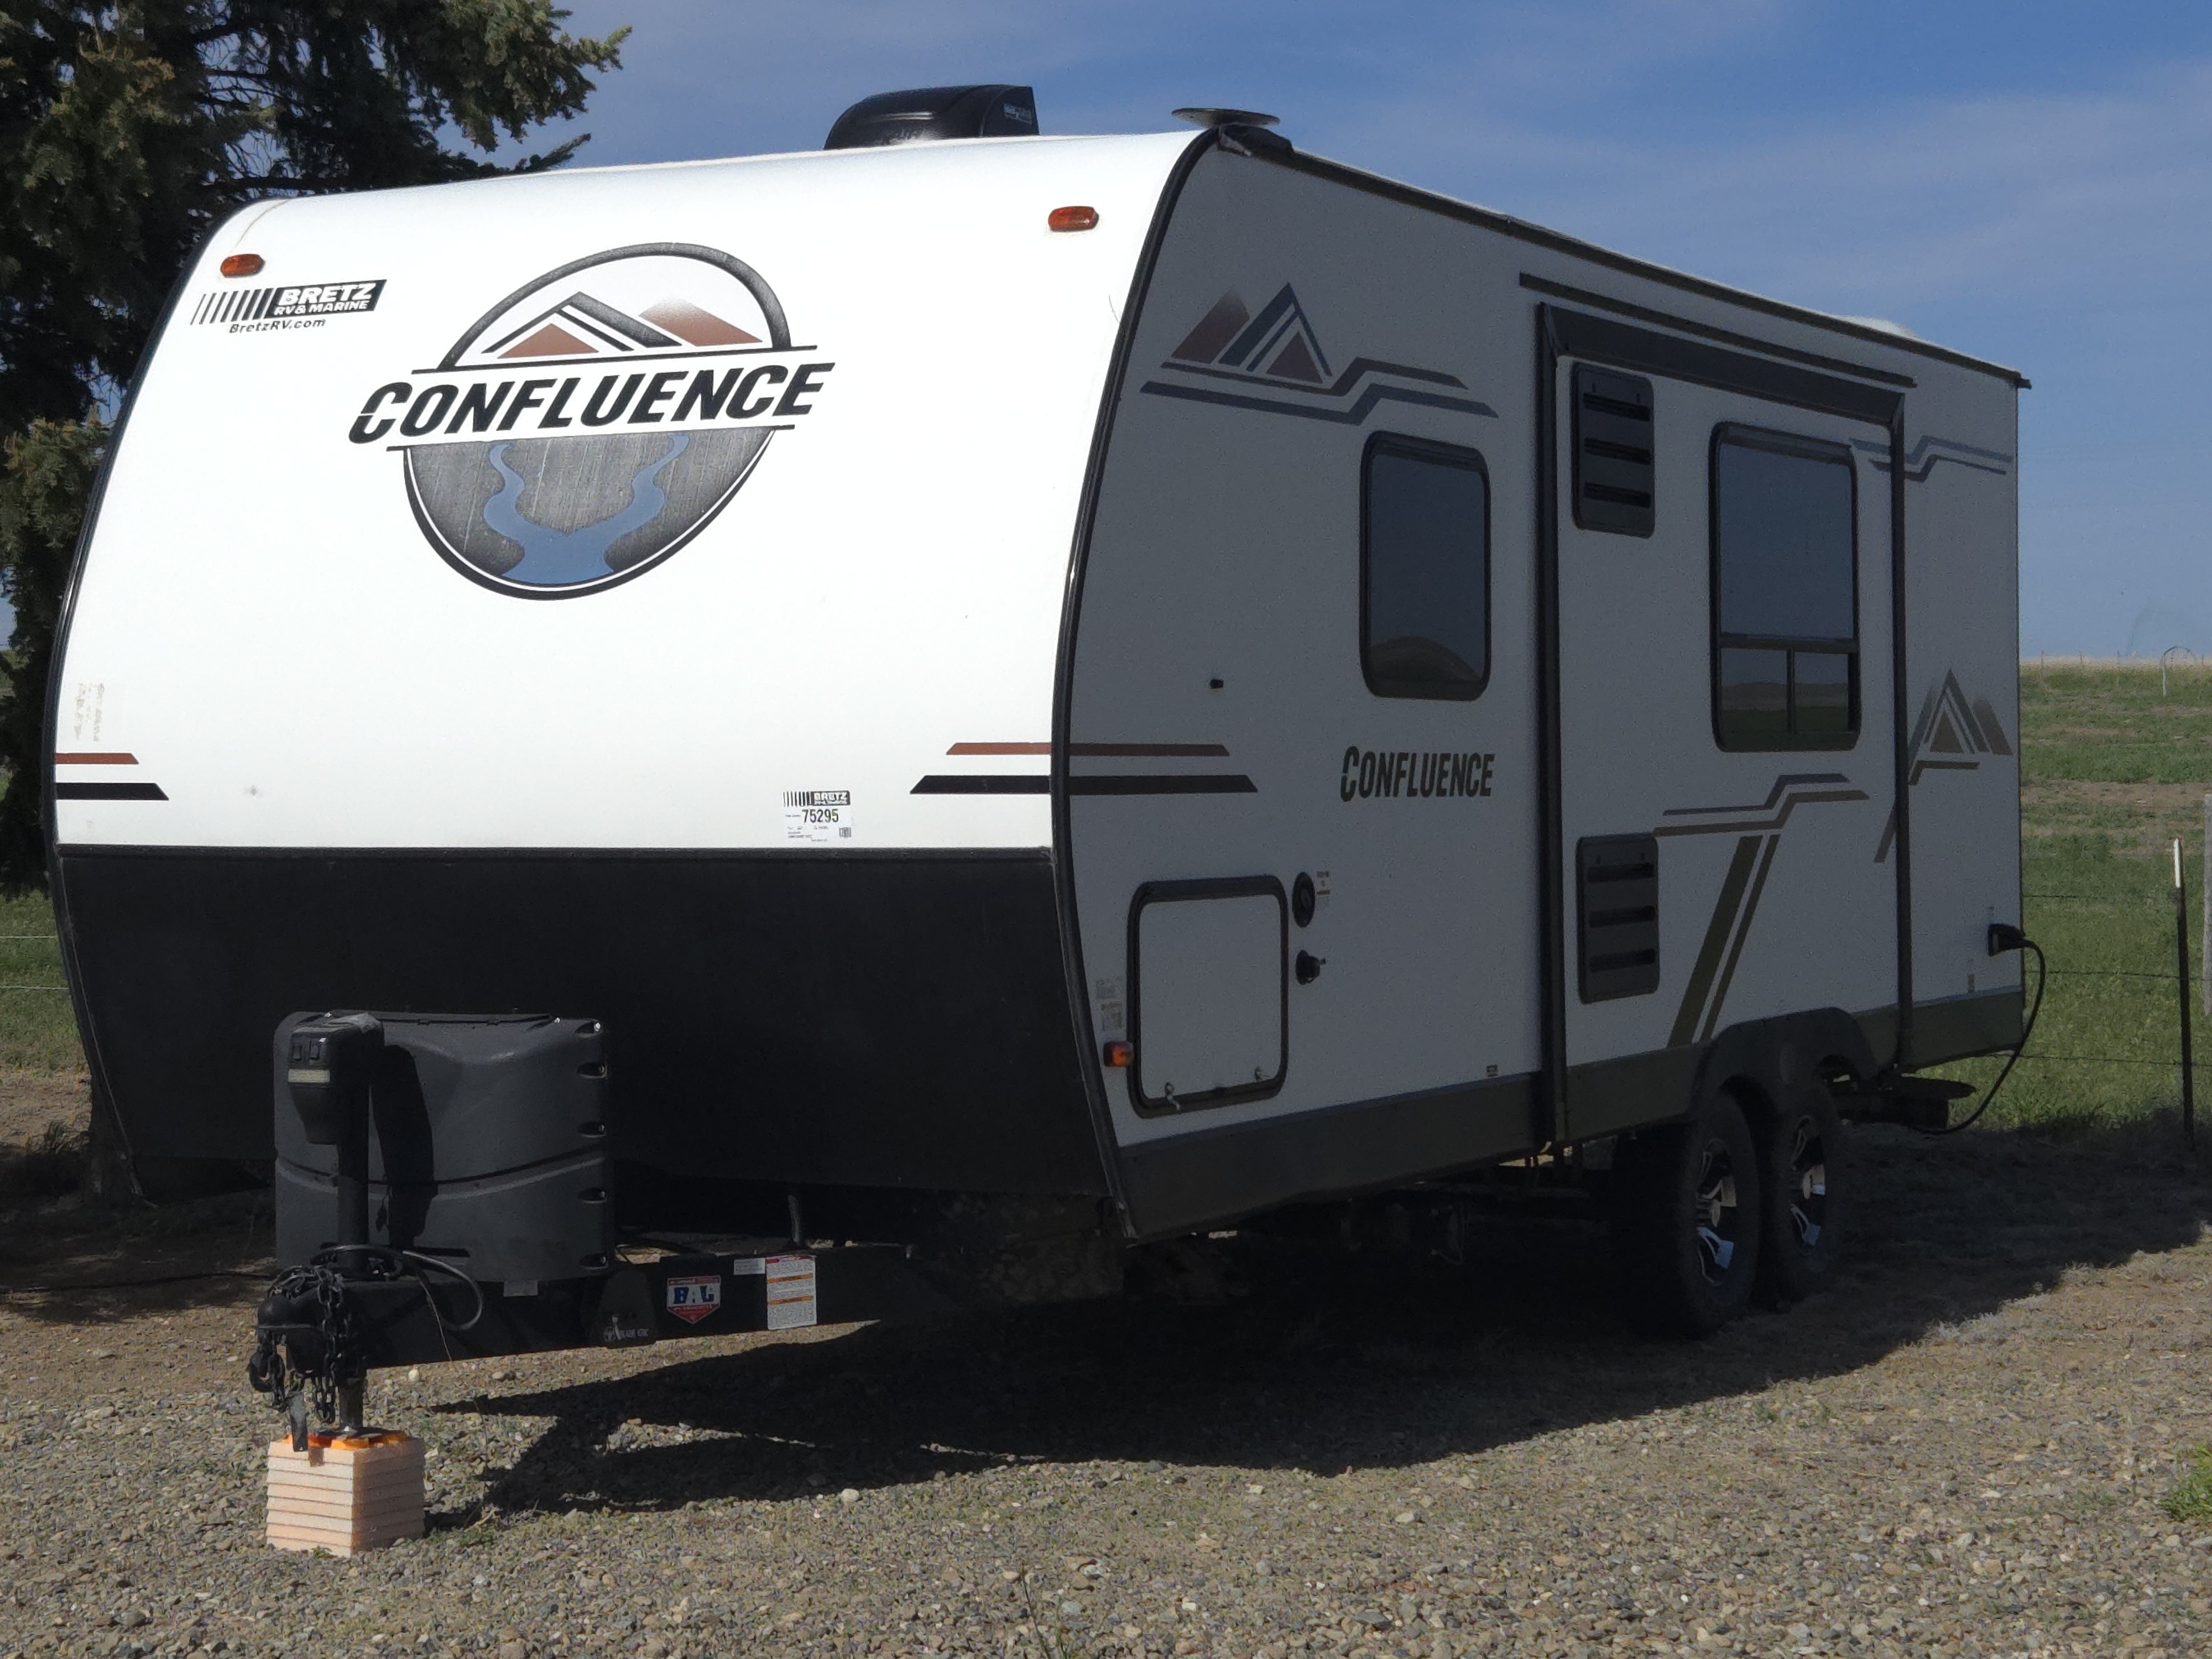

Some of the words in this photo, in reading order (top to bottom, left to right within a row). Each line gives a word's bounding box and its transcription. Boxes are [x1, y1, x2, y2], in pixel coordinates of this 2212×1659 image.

[278, 283, 376, 306] BRETZ
[309, 300, 369, 313] MARINE
[229, 319, 325, 333] BretzRV.com
[348, 362, 836, 444] CONFLUENCE
[1340, 746, 1495, 802] CONFLUENCE
[802, 809, 839, 823] 75295
[673, 1286, 714, 1304] BAL
